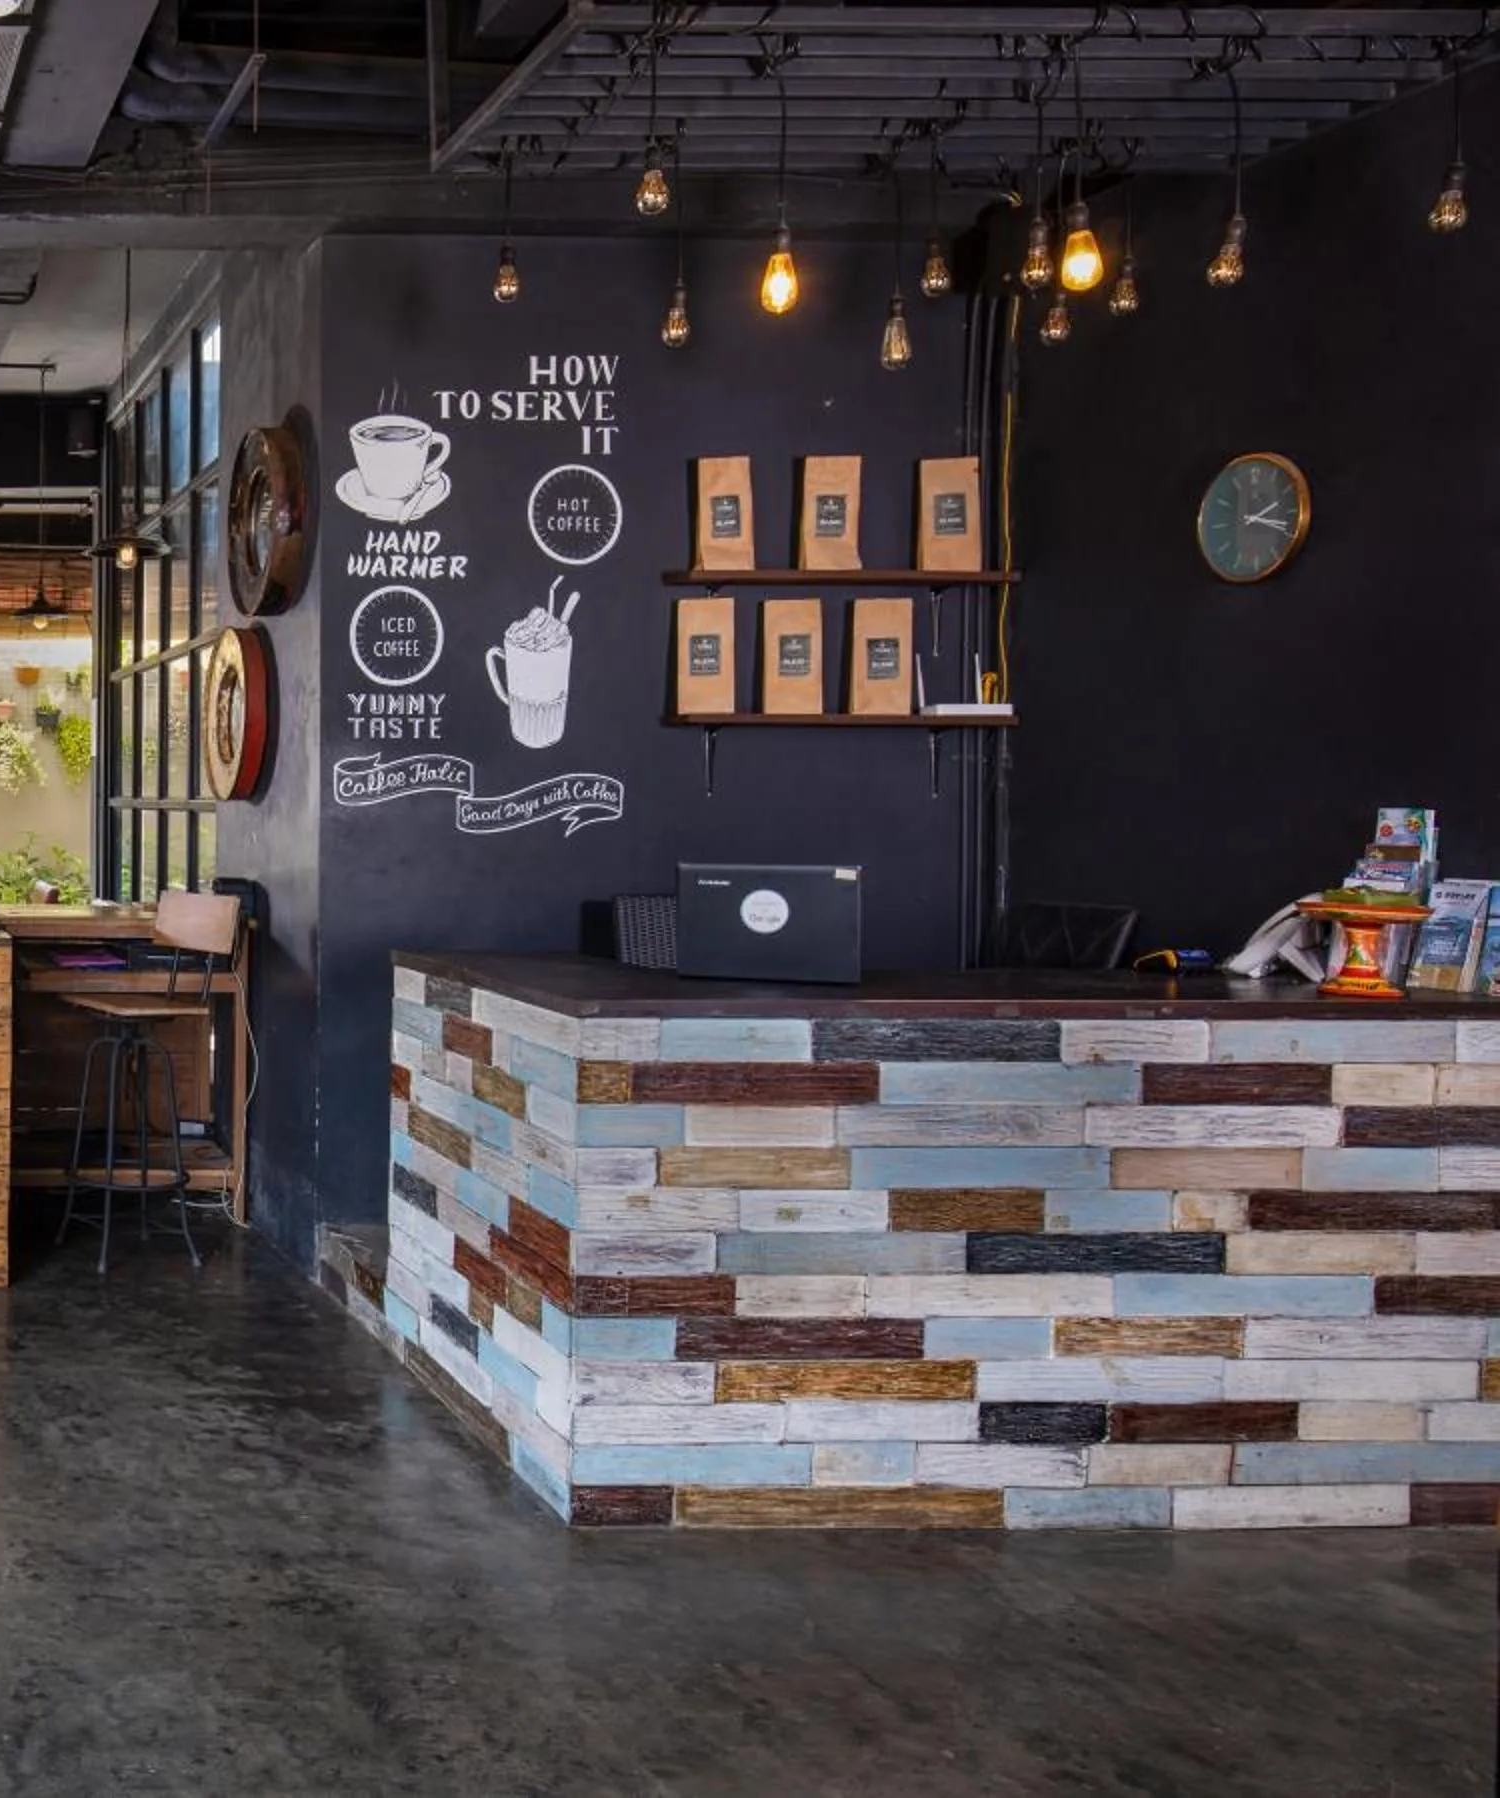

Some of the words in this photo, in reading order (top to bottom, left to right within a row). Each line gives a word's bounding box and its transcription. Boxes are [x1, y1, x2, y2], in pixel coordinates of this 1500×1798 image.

[529, 355, 619, 385] HOW
[433, 391, 481, 419] TO
[491, 391, 615, 421] SERVE
[581, 426, 619, 455] IT
[557, 498, 588, 511] HOT
[547, 516, 601, 533] COFFEE
[365, 530, 441, 553] HAND
[347, 555, 468, 579] WARMER
[380, 617, 416, 633] ICED
[373, 640, 421, 657] COFFEE
[347, 693, 446, 715] YUMMY
[348, 717, 442, 739] TASTE
[339, 771, 406, 797] Coffee
[461, 803, 503, 824] Good
